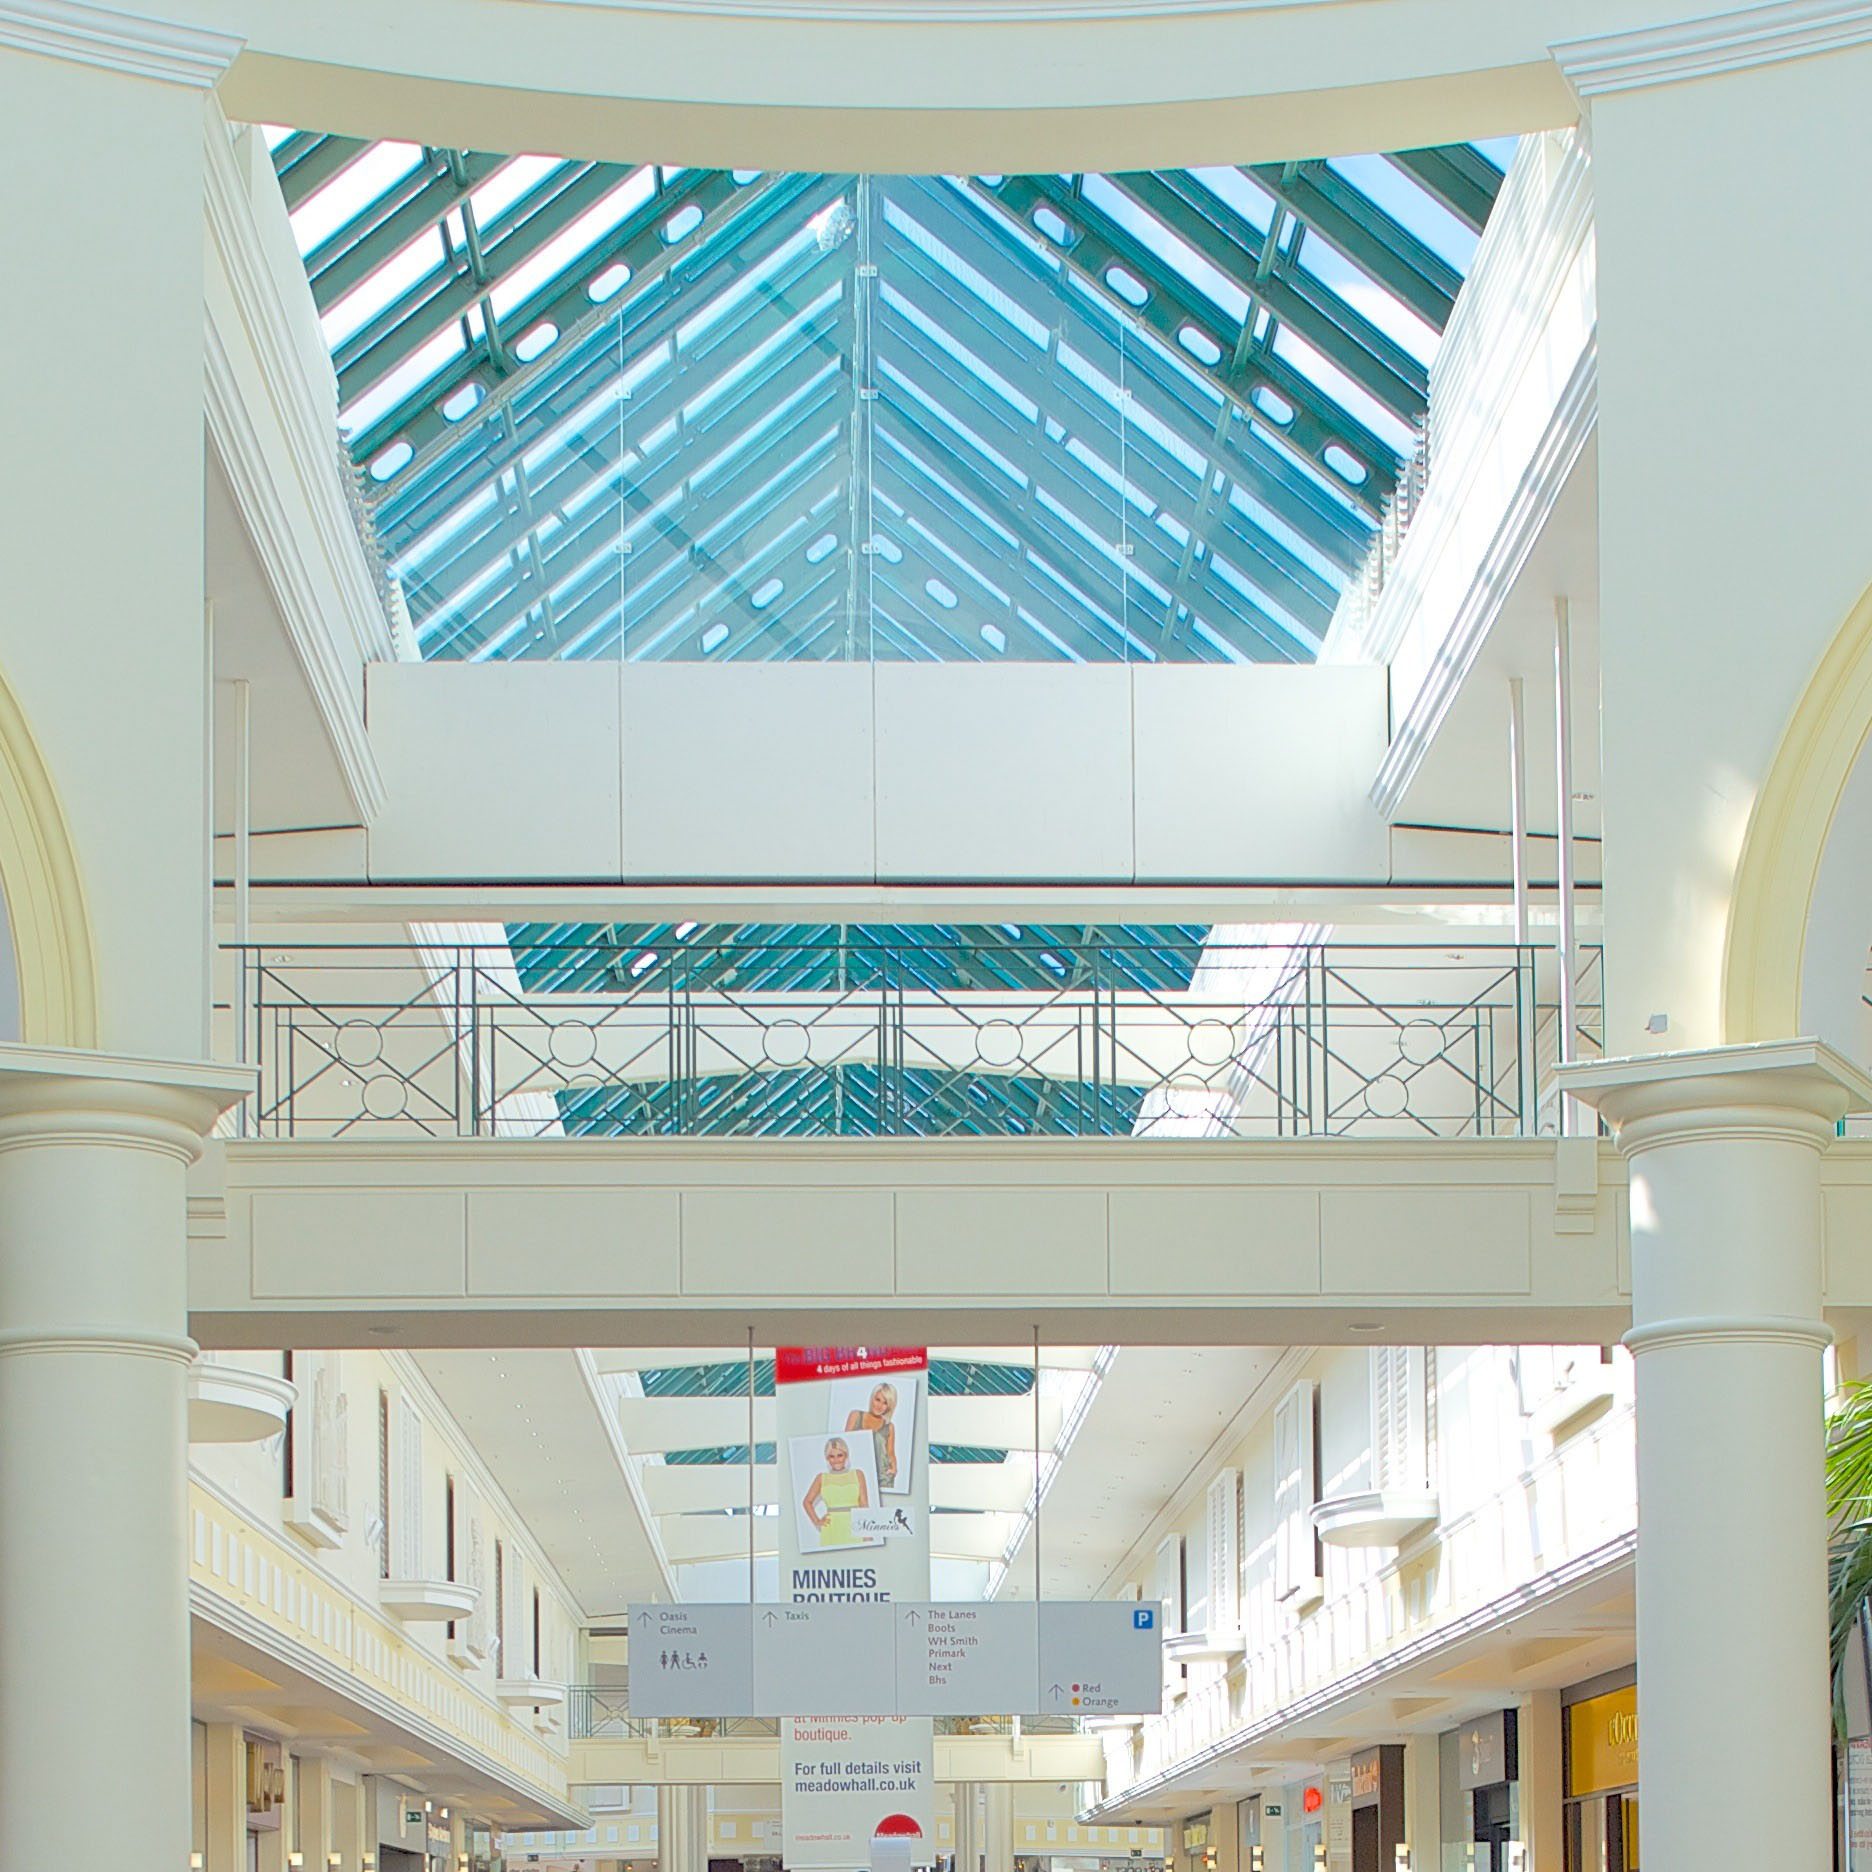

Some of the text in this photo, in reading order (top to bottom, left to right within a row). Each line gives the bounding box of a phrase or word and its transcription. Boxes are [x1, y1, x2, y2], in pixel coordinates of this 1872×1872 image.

[793, 1568, 877, 1589] MINNIES
[660, 1612, 688, 1621] Oasis
[785, 1611, 810, 1620] Taxis
[928, 1610, 977, 1620] The Lanes
[660, 1625, 698, 1635] Cinema
[928, 1623, 956, 1633] Boots
[928, 1636, 978, 1646] WH Smith
[929, 1649, 966, 1658] Primark
[929, 1662, 953, 1672] Next
[929, 1675, 947, 1685] Bhs
[1082, 1684, 1102, 1694] Red
[1082, 1697, 1119, 1709] Orange
[794, 1728, 853, 1744] boutique.
[795, 1760, 922, 1776] For full details visit
[795, 1777, 917, 1793] meadowhall.co.uk
